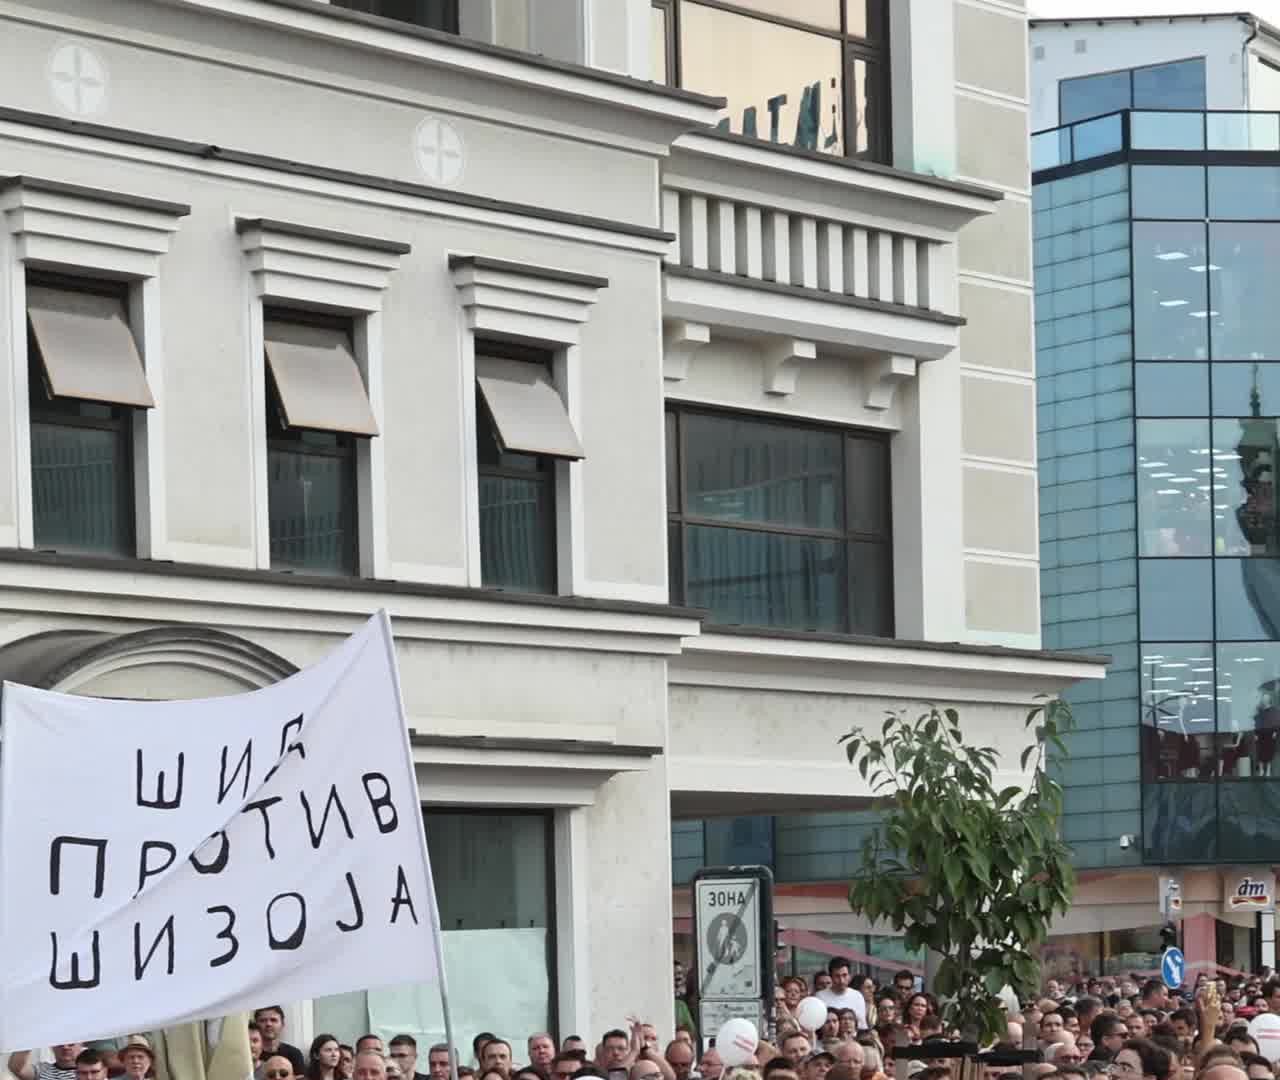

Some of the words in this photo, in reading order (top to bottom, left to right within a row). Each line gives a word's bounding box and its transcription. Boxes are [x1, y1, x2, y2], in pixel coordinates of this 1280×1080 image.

[136, 713, 306, 809] ШИД
[50, 772, 398, 900] ПРОТИВ
[49, 865, 418, 989] ШИЗОЈА
[708, 891, 746, 907] ЗОНА
[1238, 879, 1265, 896] dm
